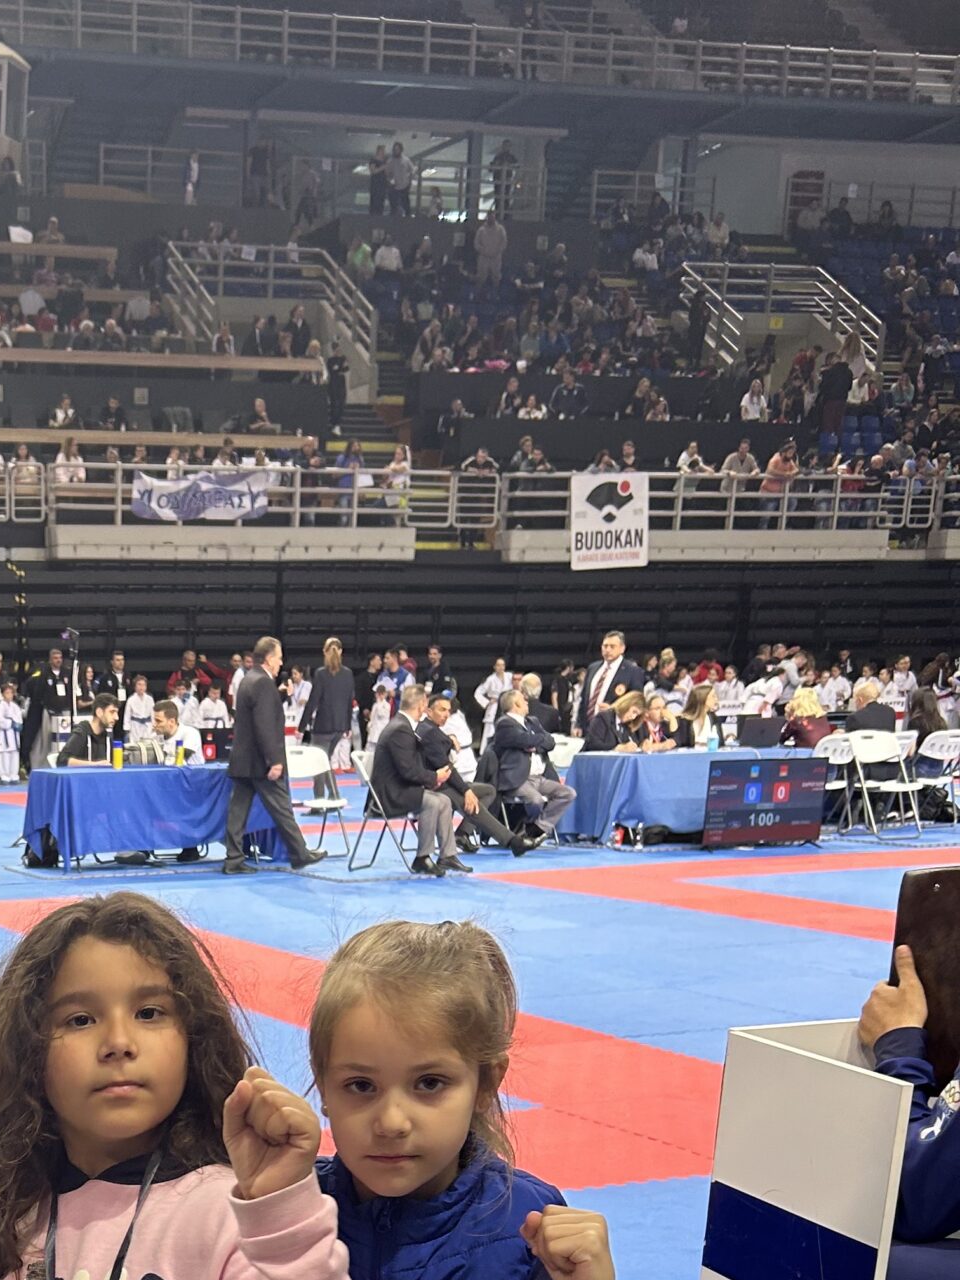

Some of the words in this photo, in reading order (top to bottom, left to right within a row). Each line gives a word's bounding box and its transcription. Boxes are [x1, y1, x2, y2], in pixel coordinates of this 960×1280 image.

[575, 528, 644, 551] BUDOKAN
[748, 787, 756, 800] 0
[777, 786, 785, 799] 0
